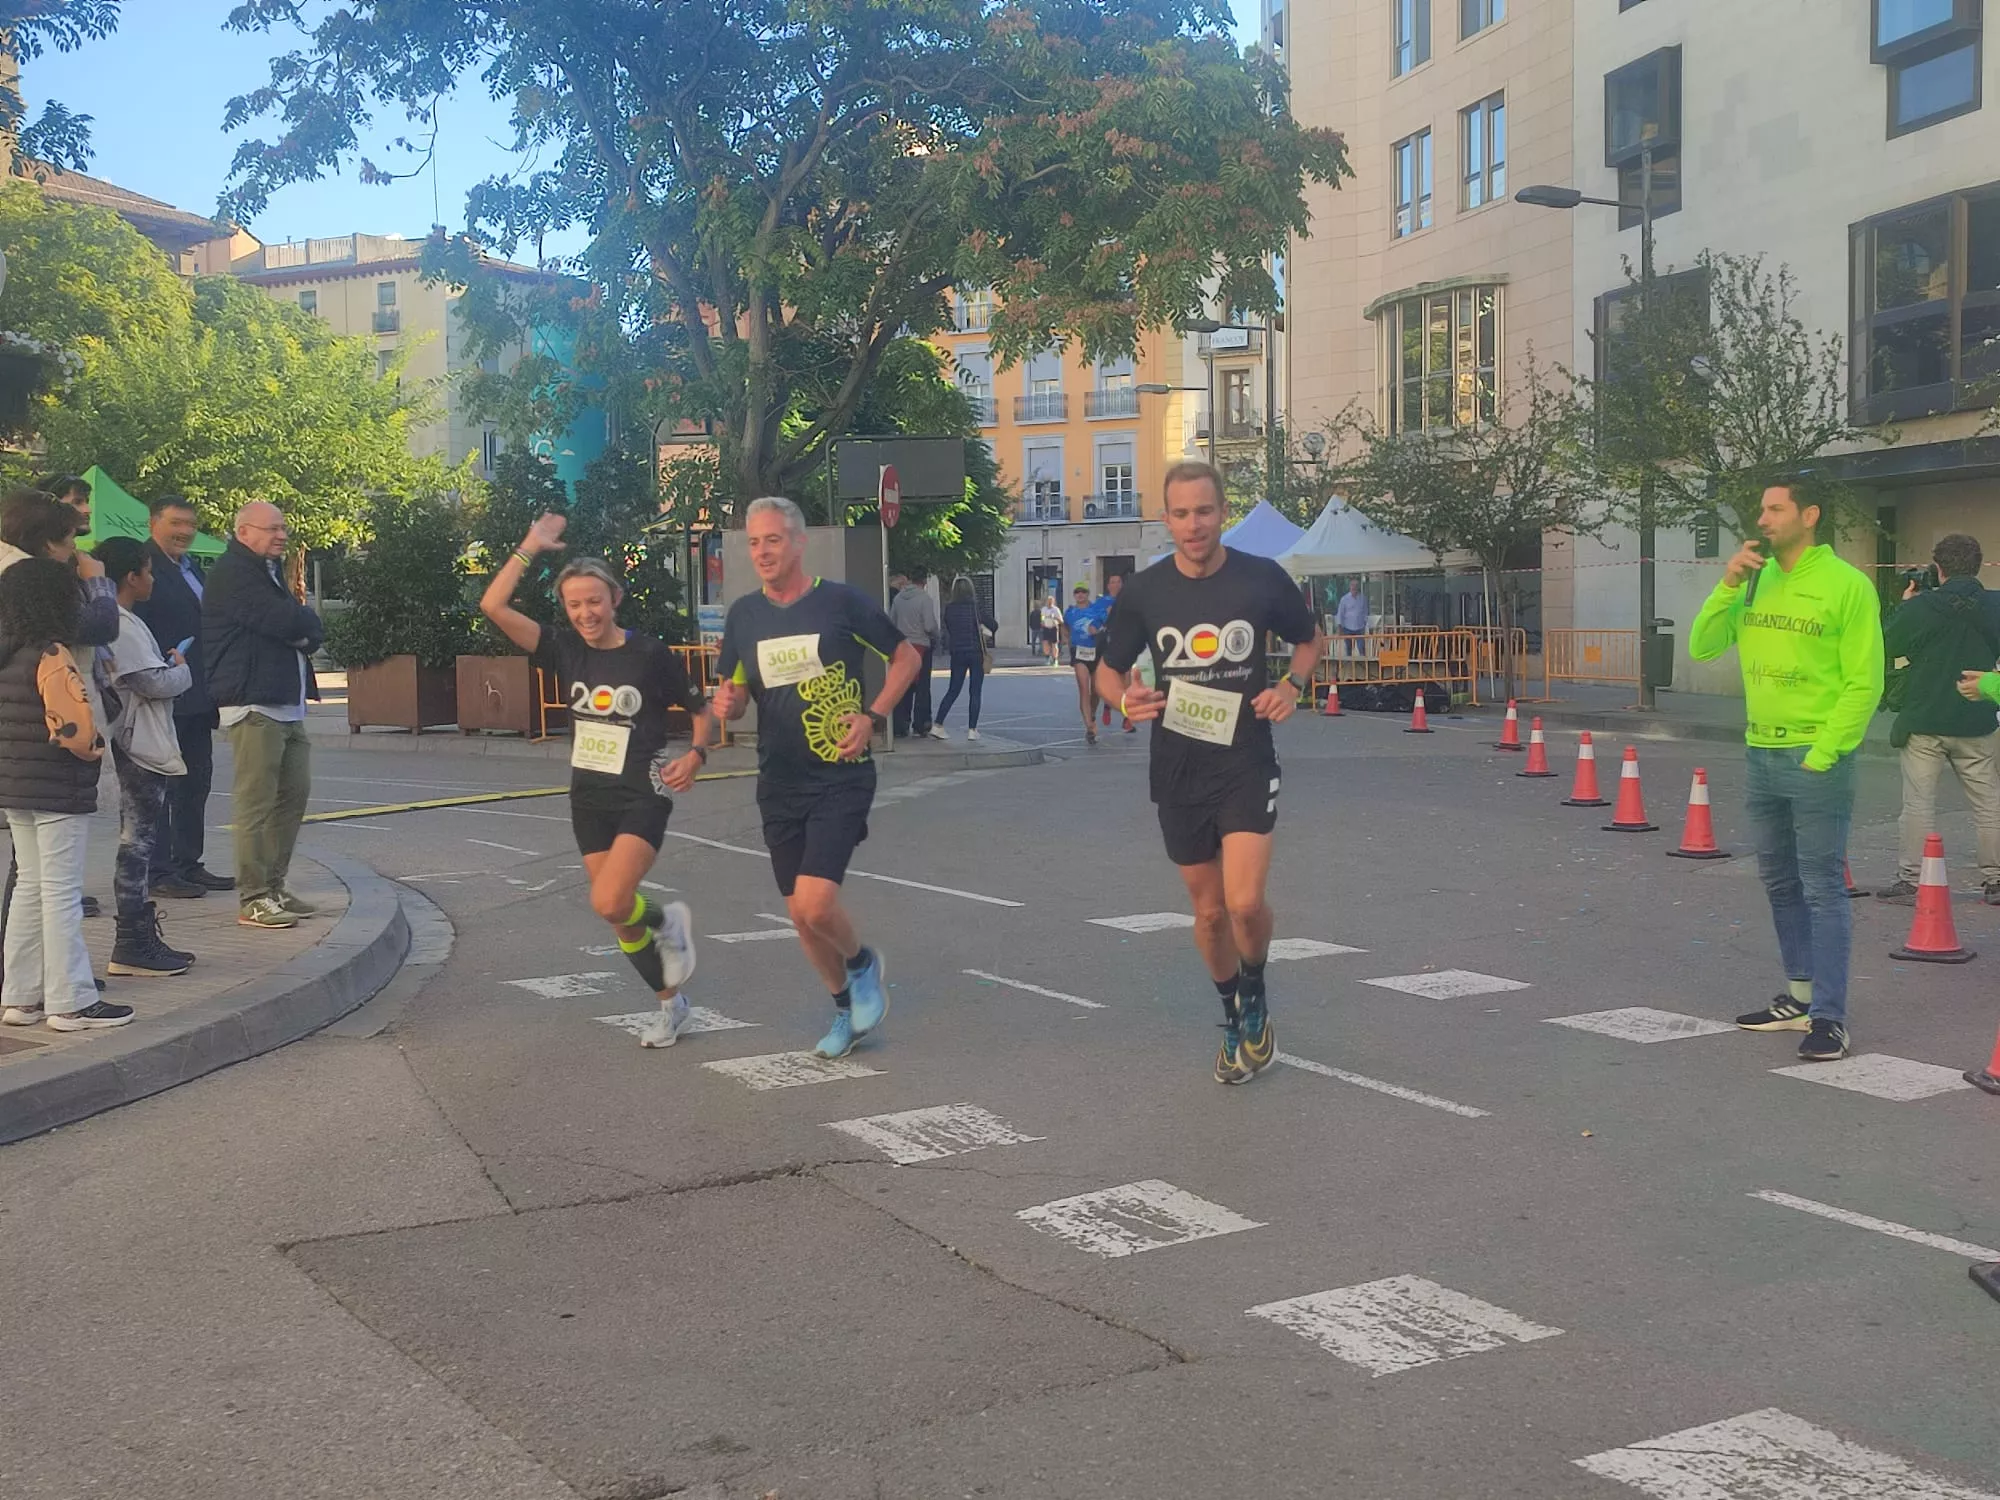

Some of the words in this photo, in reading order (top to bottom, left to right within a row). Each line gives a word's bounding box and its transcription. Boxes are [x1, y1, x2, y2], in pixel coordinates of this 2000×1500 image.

[1744, 612, 1825, 638] ORGANIZACIÓN
[767, 645, 809, 667] 3061
[1157, 619, 1255, 668] 200
[570, 681, 643, 717] 200
[1175, 698, 1228, 724] 3060
[579, 735, 618, 755] 3062
